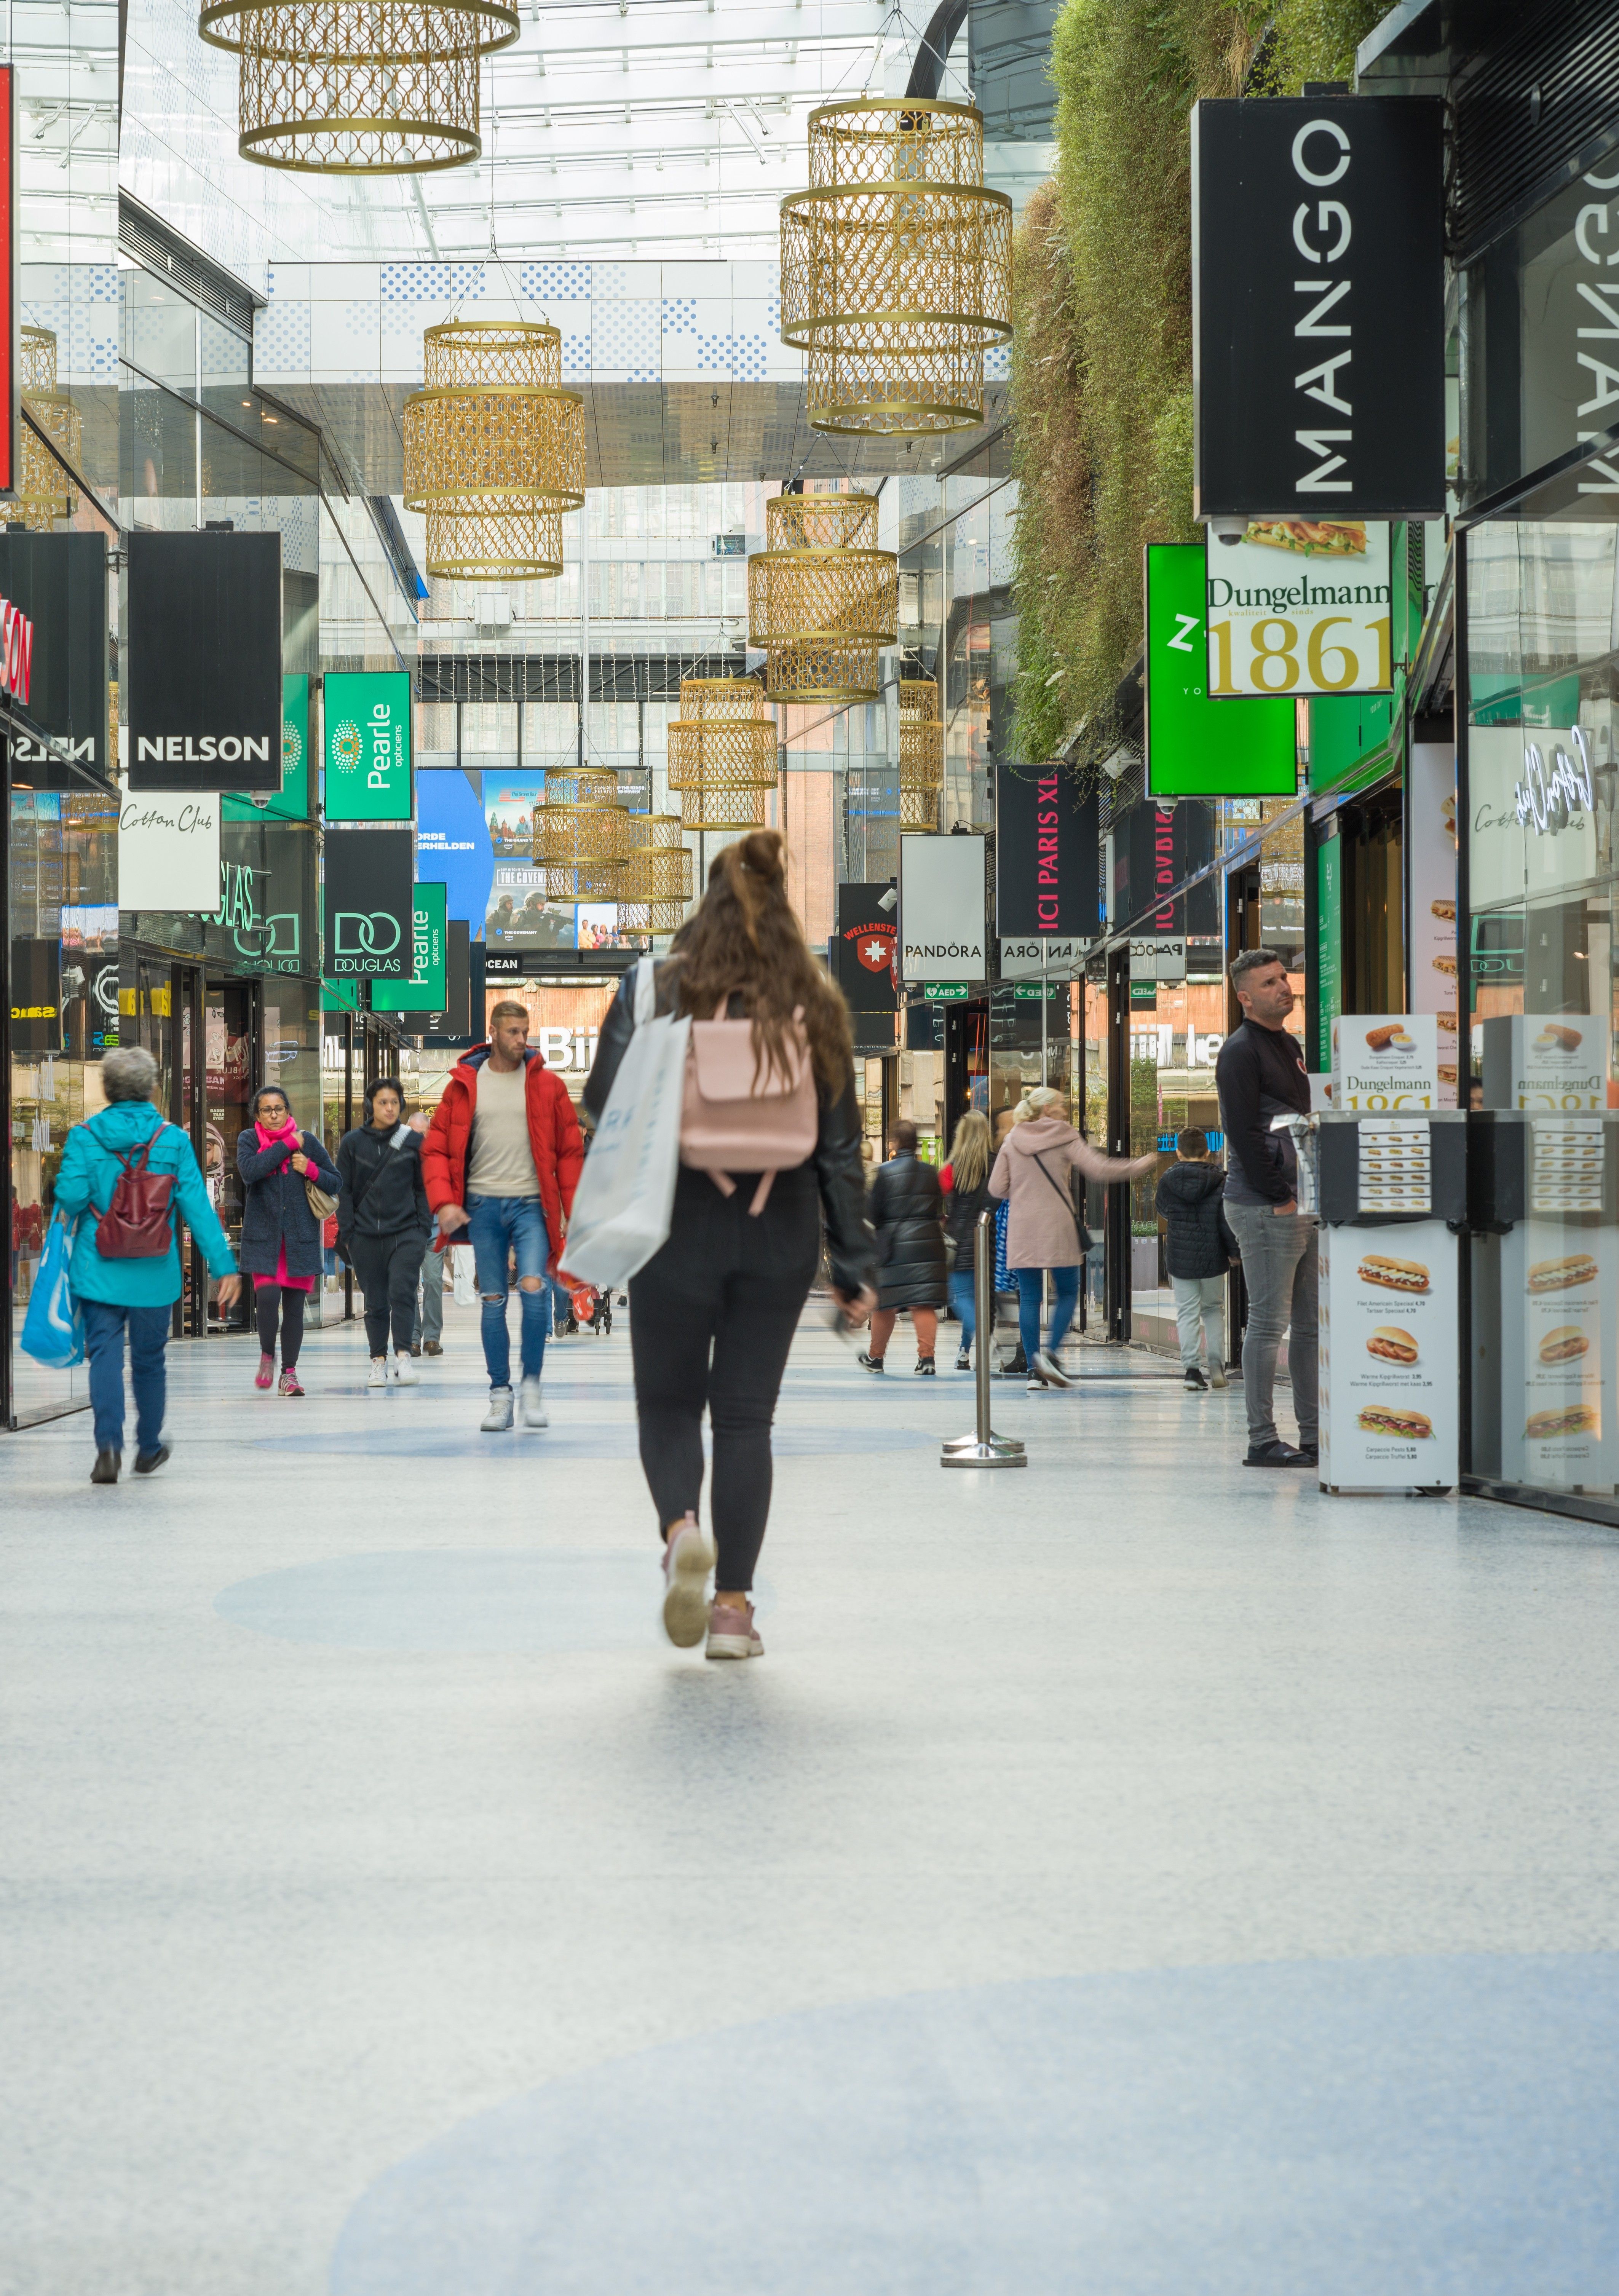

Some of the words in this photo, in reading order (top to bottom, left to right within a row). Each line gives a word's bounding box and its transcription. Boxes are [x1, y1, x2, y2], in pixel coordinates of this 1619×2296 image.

[1292, 119, 1353, 492] MANGO
[1209, 575, 1390, 613] Dungelmann
[1209, 616, 1391, 693] 1861
[138, 736, 269, 761] NELSON
[367, 704, 390, 788] Pearle
[394, 725, 404, 767] opticiens
[1038, 773, 1059, 804] XL
[120, 804, 174, 830] Cotton
[178, 805, 212, 833] Club
[1038, 811, 1059, 884] PARIS
[500, 872, 514, 883] THE
[1038, 894, 1059, 929] ICI
[335, 912, 401, 955] DO
[843, 923, 897, 940] WELLENSTE
[335, 959, 401, 972] DOUGLAS
[486, 960, 517, 969] CEAN
[905, 945, 982, 957] PANDORA
[1347, 1076, 1431, 1093] Dungelmann
